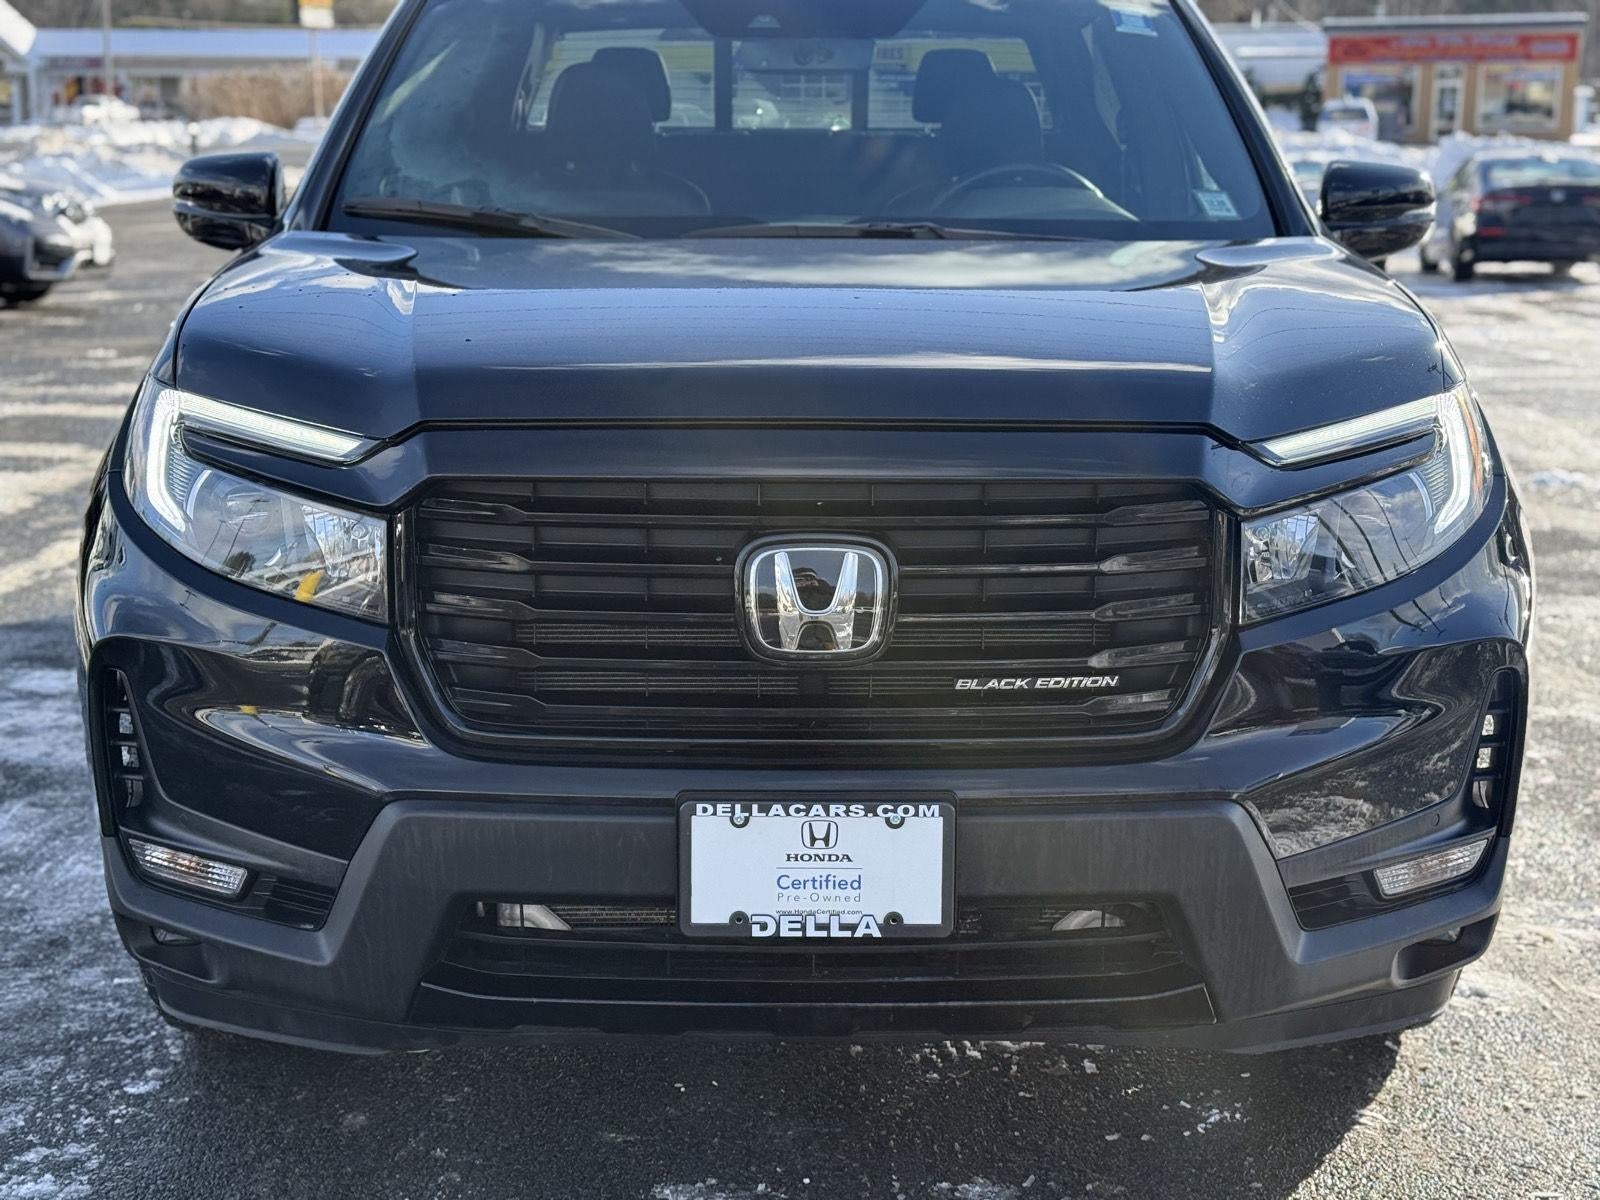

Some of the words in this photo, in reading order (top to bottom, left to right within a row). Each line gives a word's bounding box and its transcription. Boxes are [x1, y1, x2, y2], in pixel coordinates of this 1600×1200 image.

[955, 677, 1031, 690] BLACK
[1034, 676, 1119, 688] EDITION
[695, 803, 940, 818] DELLACARS.COM
[785, 853, 853, 862] HONDA
[776, 874, 862, 890] Certified
[777, 892, 861, 902] Pre-Owned
[751, 914, 882, 938] DELLA
